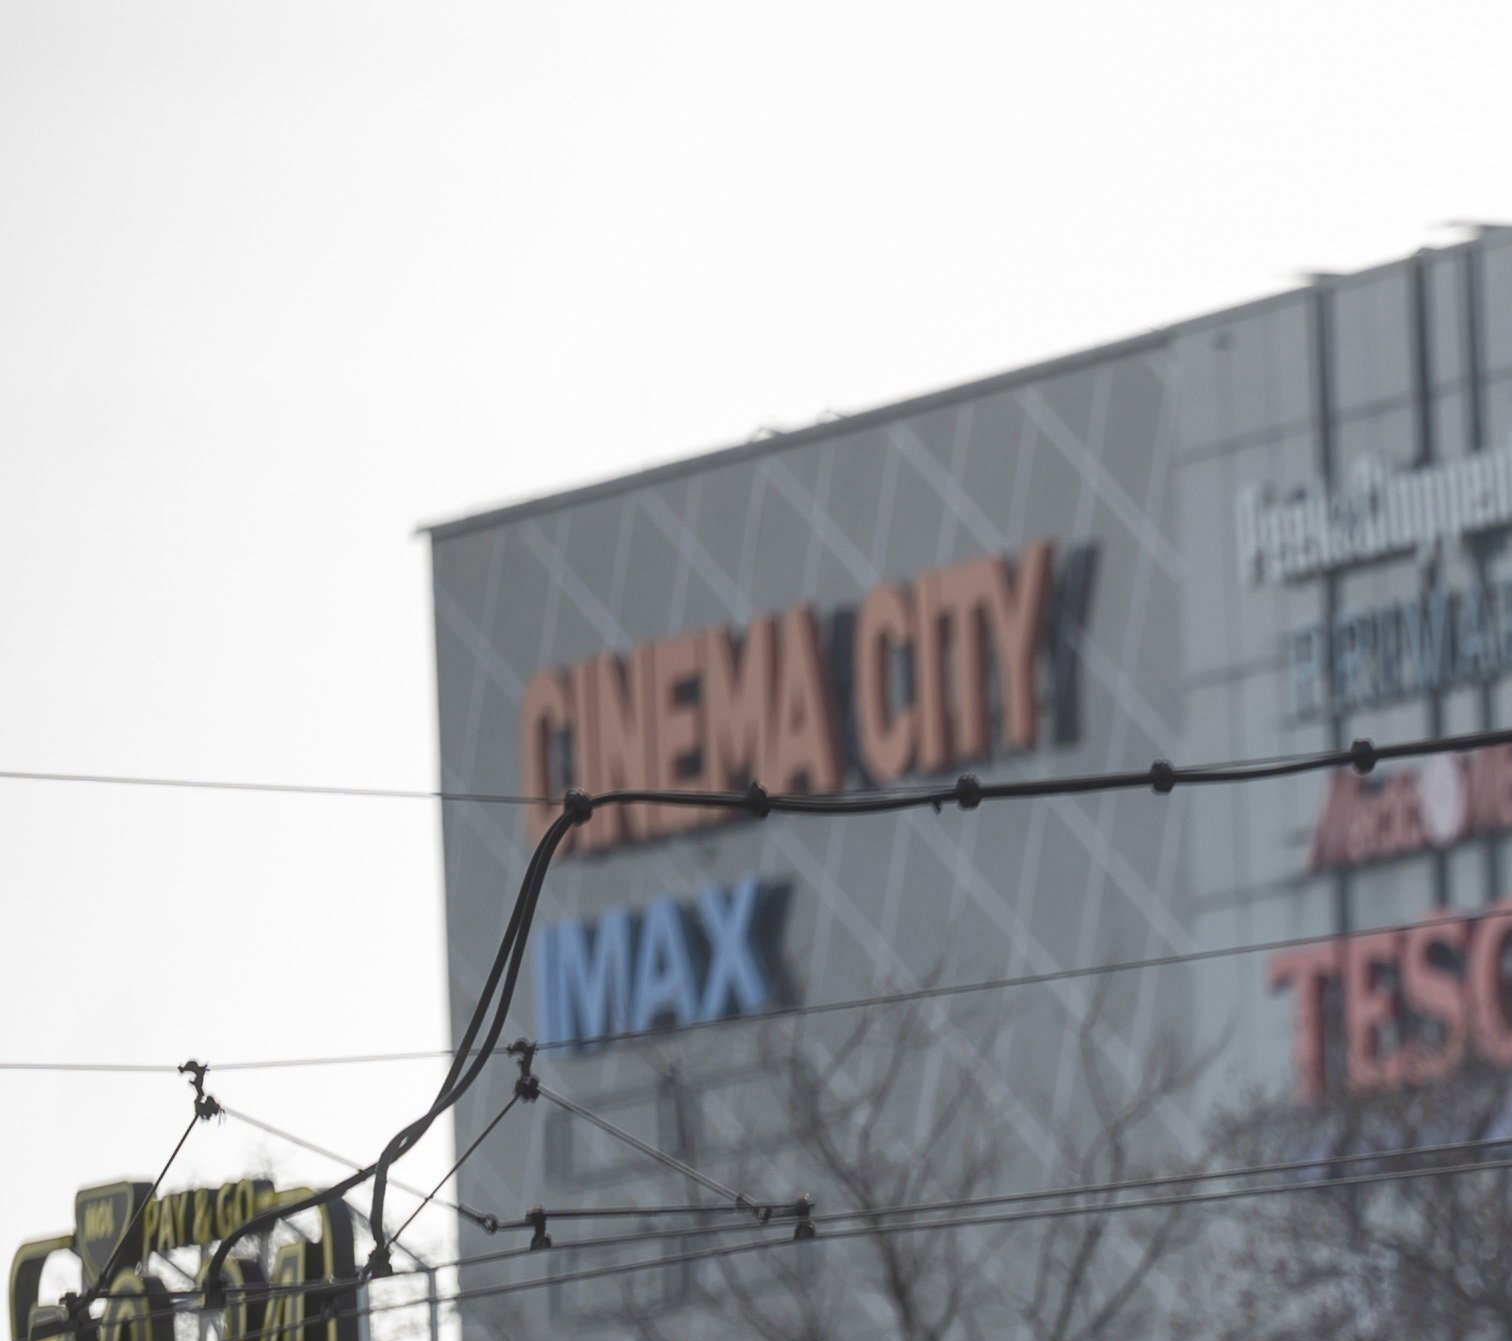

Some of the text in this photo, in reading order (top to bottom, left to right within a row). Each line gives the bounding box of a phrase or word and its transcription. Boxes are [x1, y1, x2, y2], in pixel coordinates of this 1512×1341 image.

[521, 541, 1056, 862] CINEMA CITY
[534, 878, 774, 1056] IMAX
